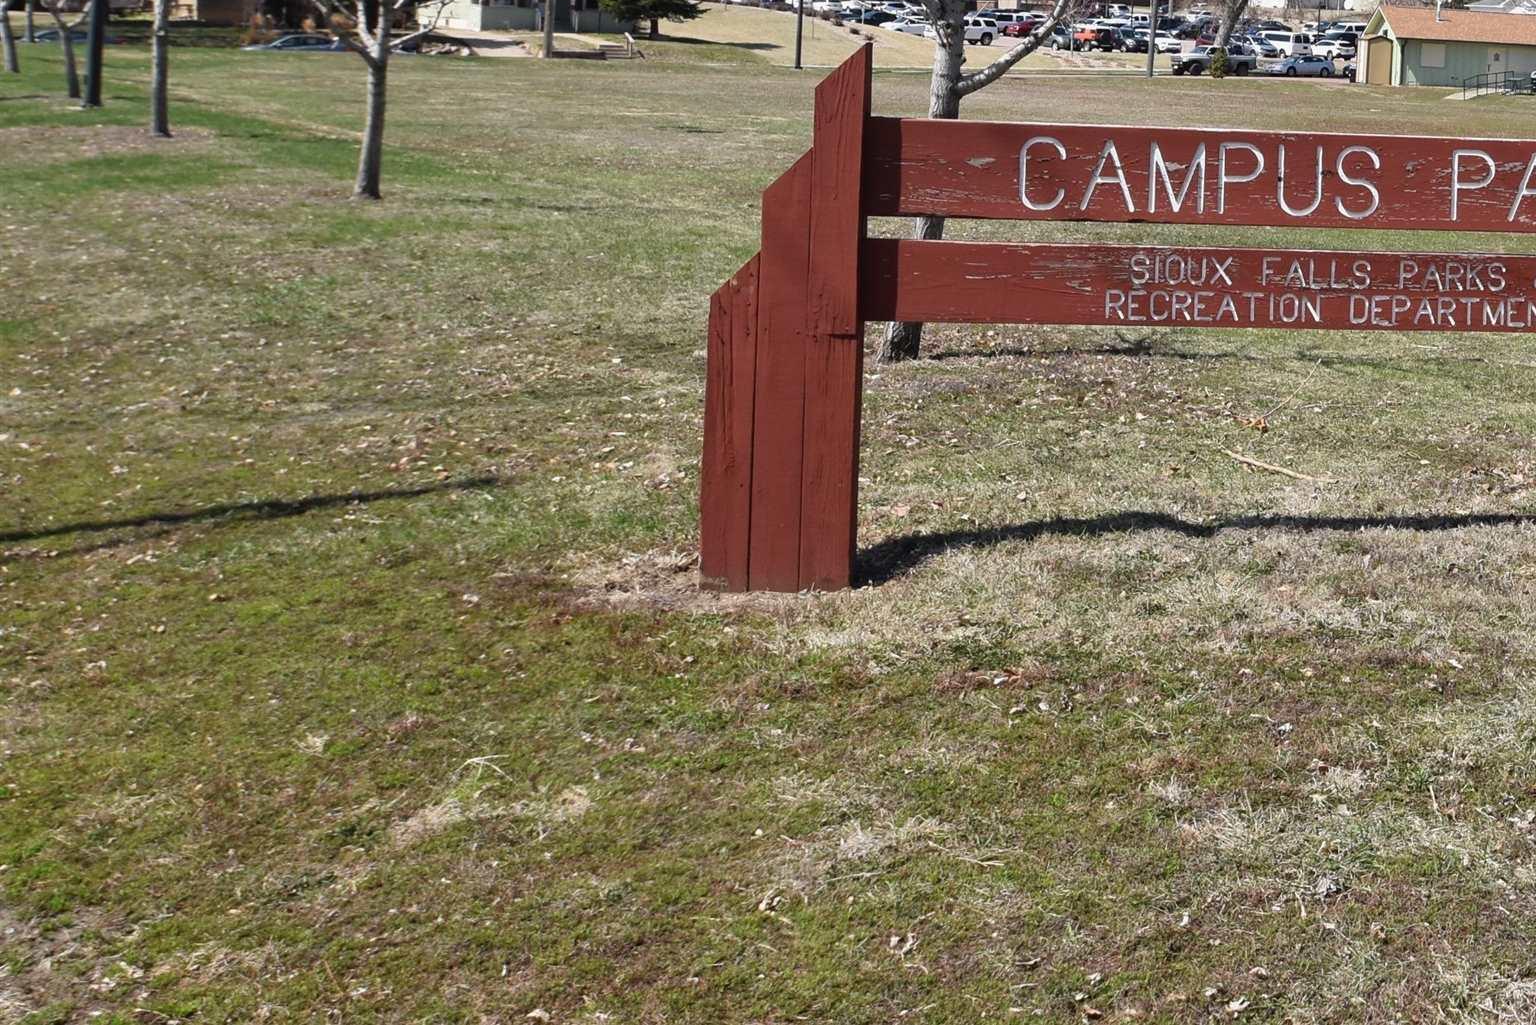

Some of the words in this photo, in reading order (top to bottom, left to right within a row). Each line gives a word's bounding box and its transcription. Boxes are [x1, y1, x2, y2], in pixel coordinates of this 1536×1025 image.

[1017, 136, 1380, 218] CAMPUS
[1129, 254, 1233, 286] SIOUX
[1261, 256, 1371, 290] FALLS
[1399, 260, 1506, 292] PARKS
[1104, 289, 1322, 323] RECREATION
